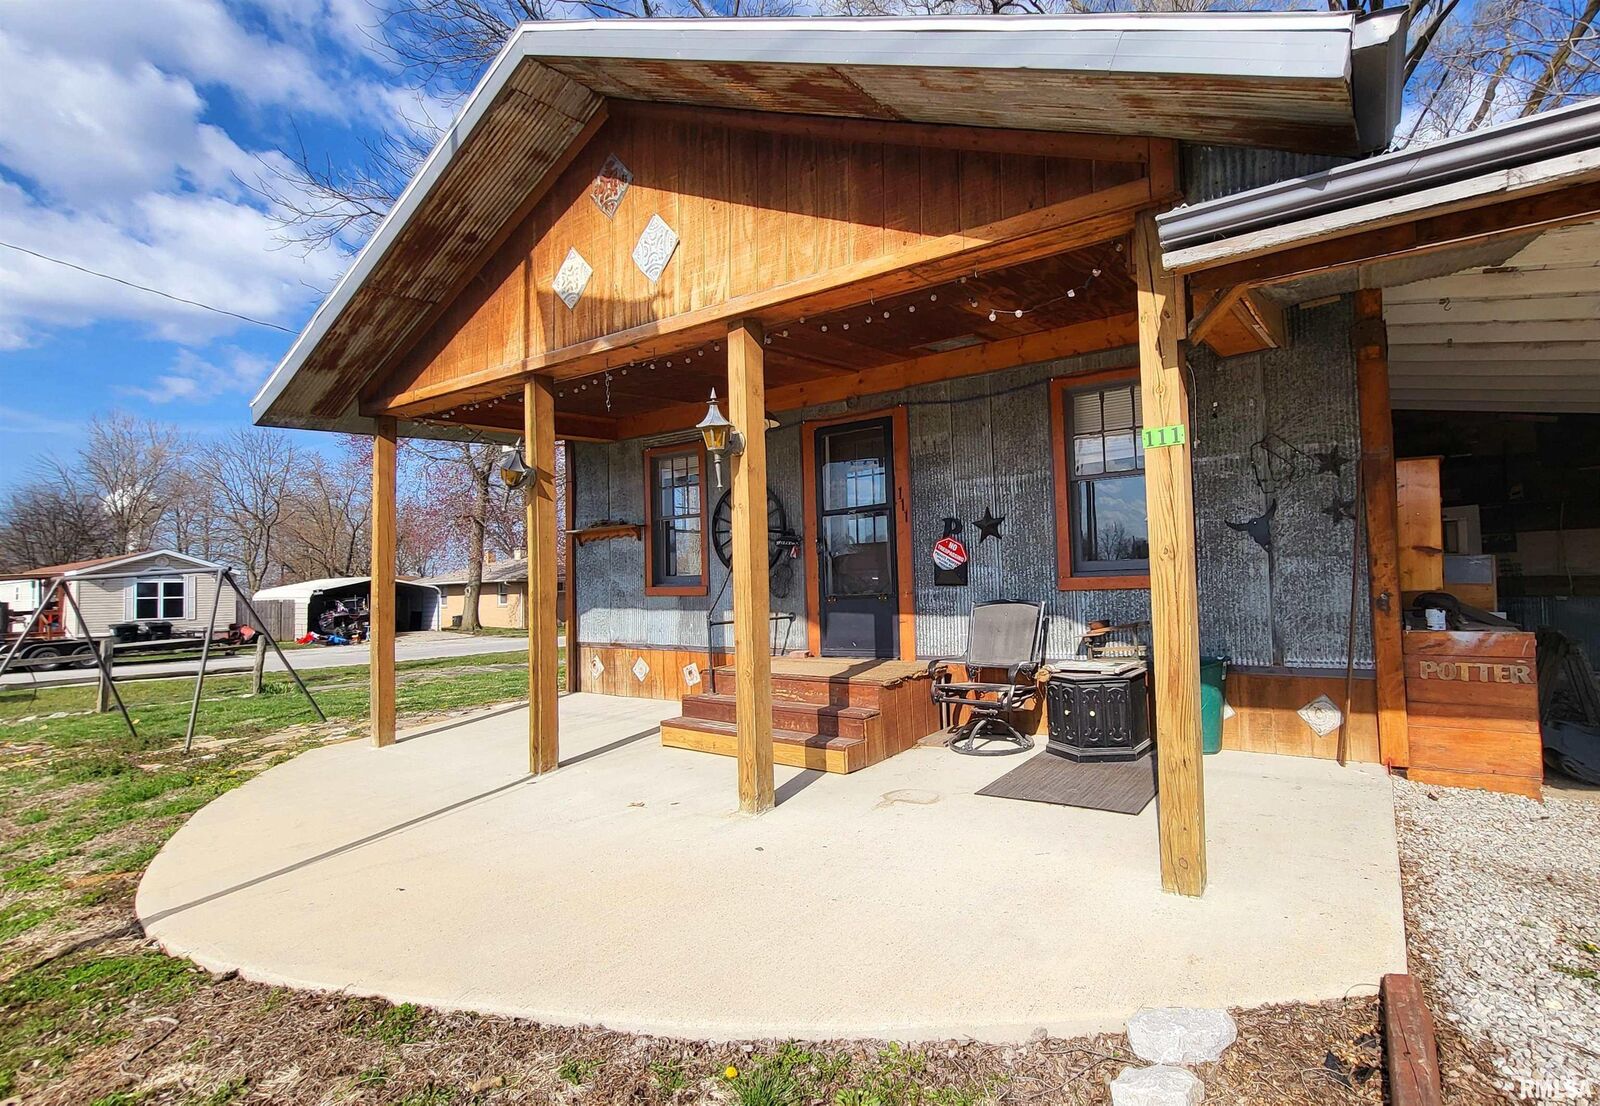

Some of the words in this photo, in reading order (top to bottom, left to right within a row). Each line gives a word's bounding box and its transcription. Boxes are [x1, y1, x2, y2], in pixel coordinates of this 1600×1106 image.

[1145, 426, 1180, 447] 111
[948, 541, 958, 551] NO
[1419, 660, 1534, 684] POTTER
